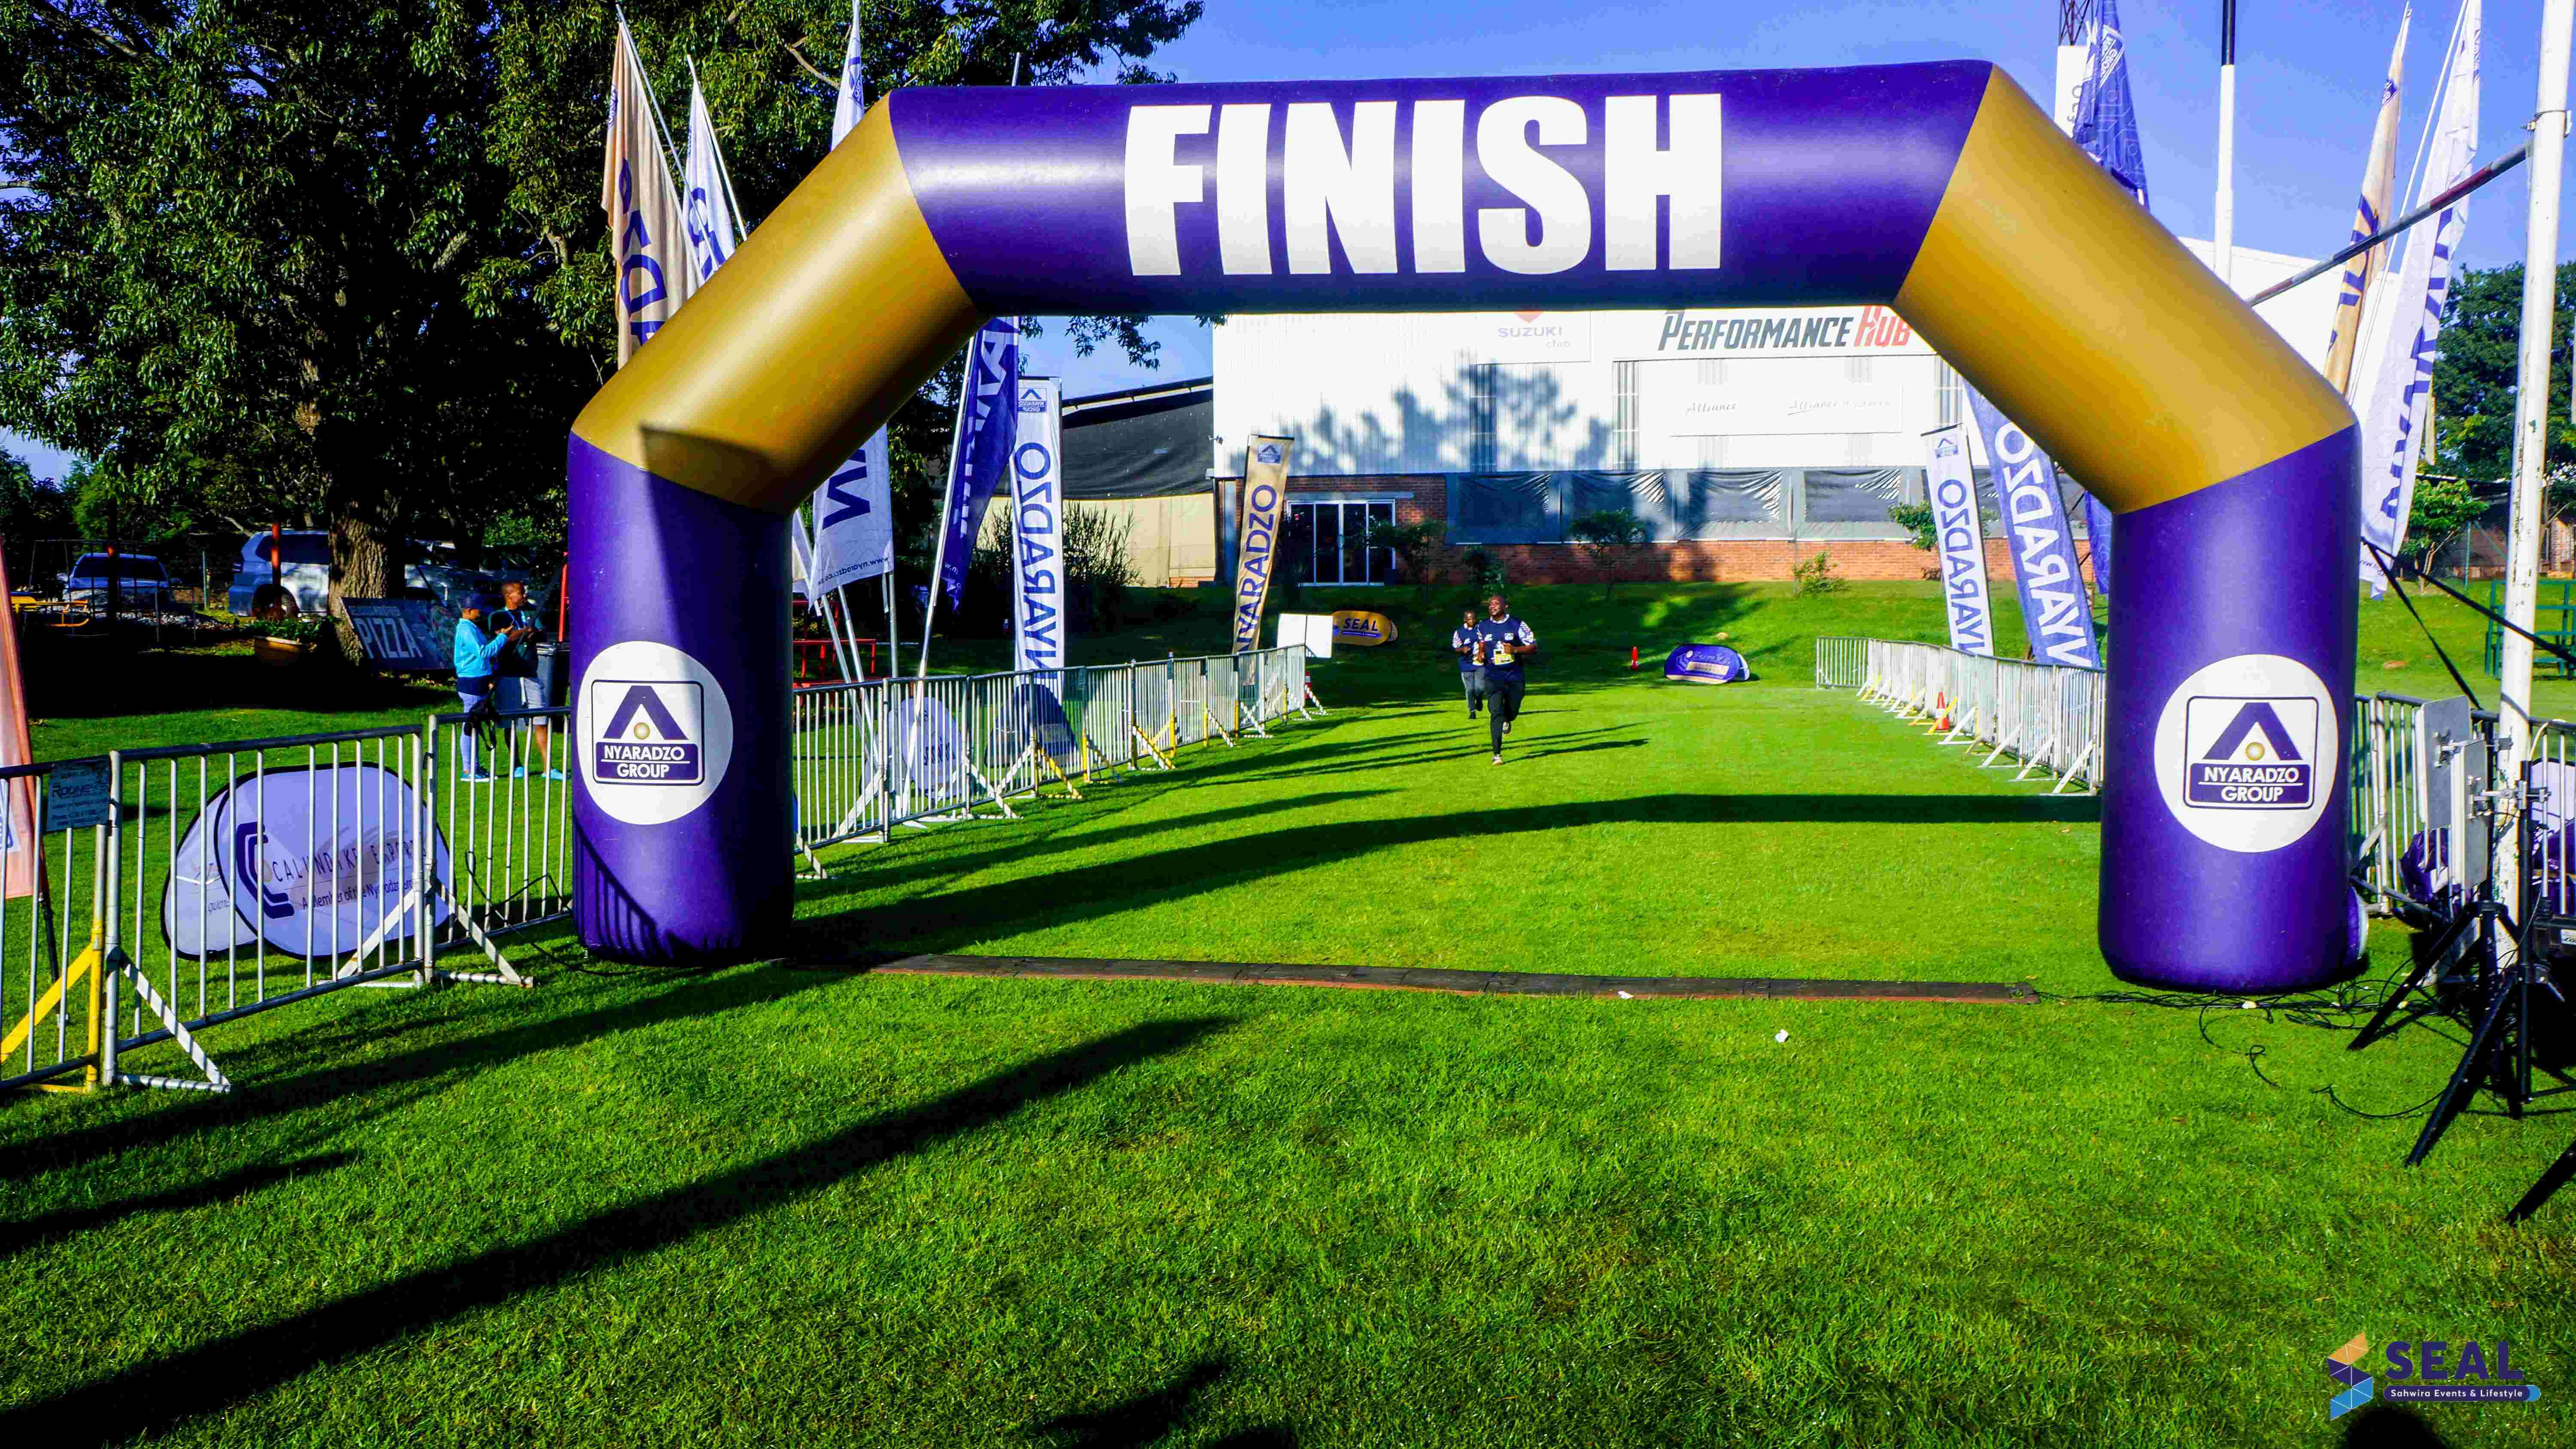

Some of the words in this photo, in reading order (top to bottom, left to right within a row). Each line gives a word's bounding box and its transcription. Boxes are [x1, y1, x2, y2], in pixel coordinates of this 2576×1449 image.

[1124, 94, 1722, 276] FINISH
[1498, 327, 1562, 337] SUZUKI
[1658, 309, 1853, 351] PERFORMANCE
[1853, 305, 1911, 348] HUB
[1343, 618, 1379, 632] SEAL
[354, 617, 423, 659] PIZZA
[604, 745, 685, 761] NYARADZO
[617, 763, 670, 778] GROUP
[2204, 767, 2300, 783] NYARADZO
[2221, 785, 2284, 802] GROUP
